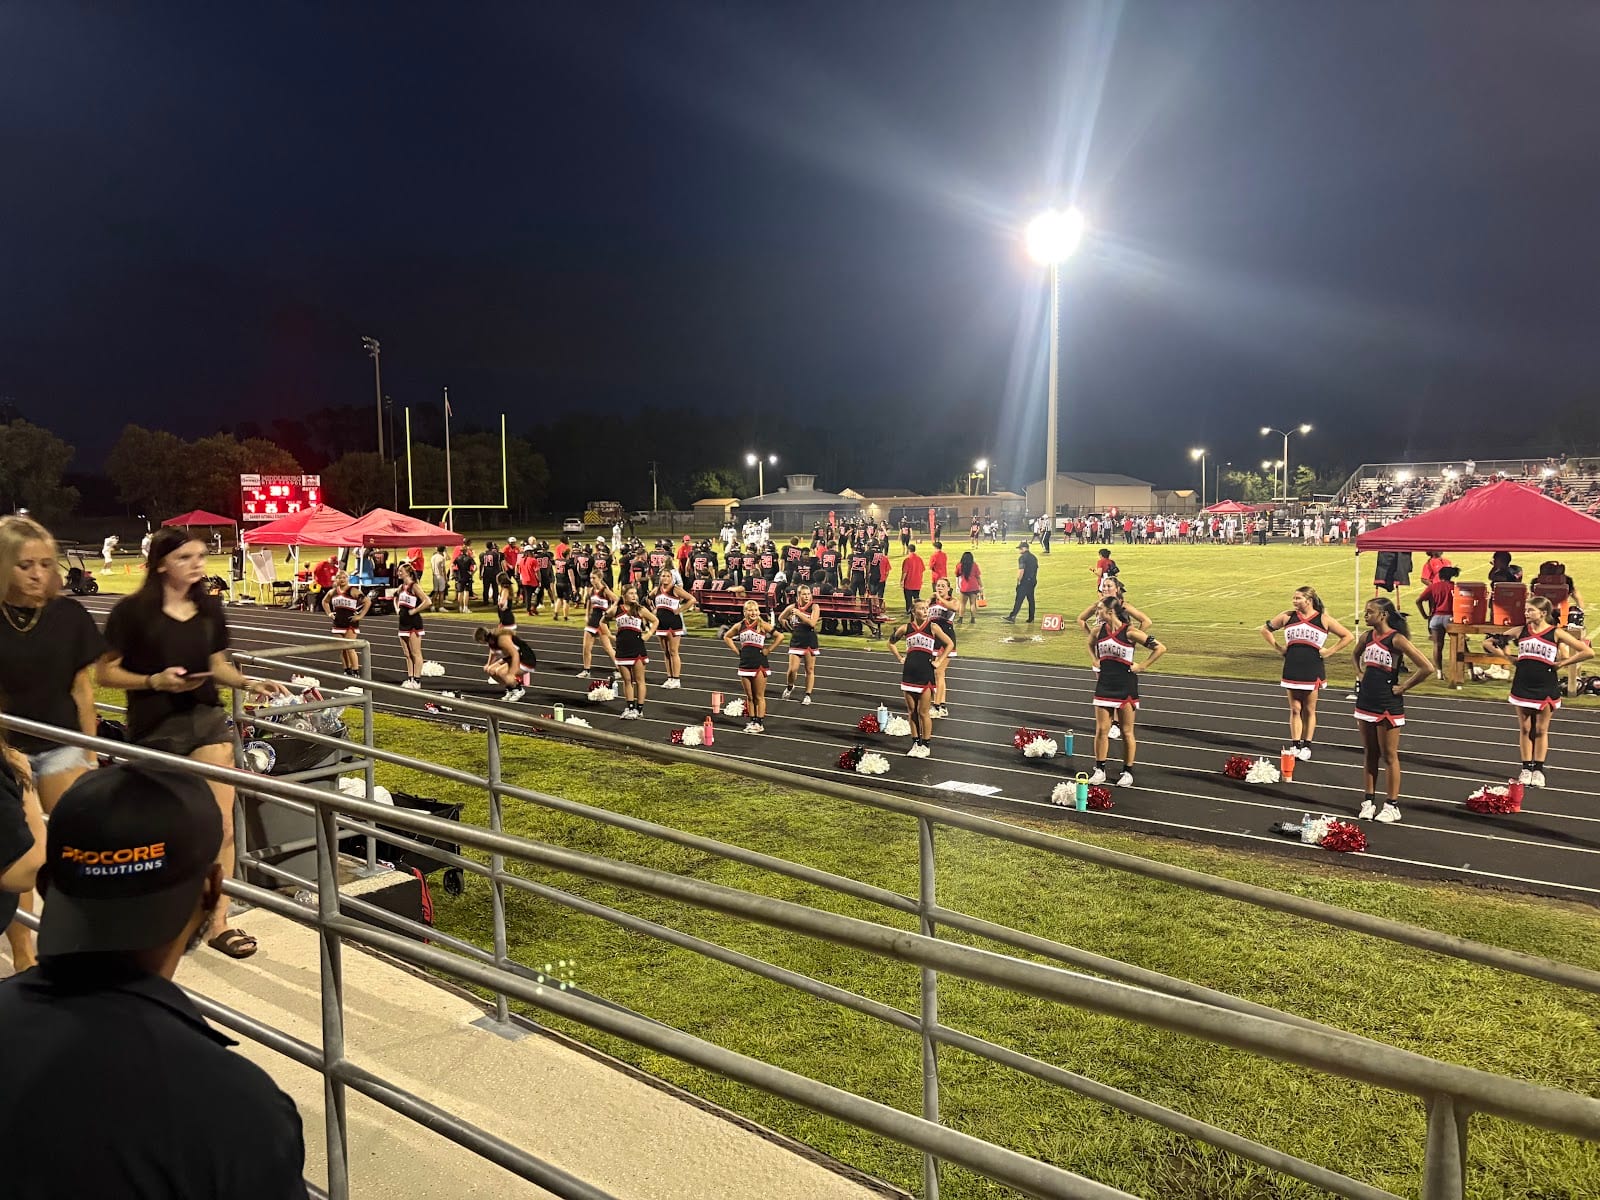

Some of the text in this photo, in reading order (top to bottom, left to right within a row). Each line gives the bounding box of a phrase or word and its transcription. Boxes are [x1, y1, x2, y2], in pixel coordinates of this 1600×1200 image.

[617, 615, 640, 627] RONCOS
[1043, 616, 1060, 629] 50
[740, 632, 763, 644] RONCOS
[1287, 628, 1320, 643] BRONCOS
[1099, 642, 1127, 658] RONCOS
[1365, 647, 1391, 665] ONCOS
[1519, 642, 1553, 659] RONCOS
[85, 860, 162, 875] SOLUTIONS
